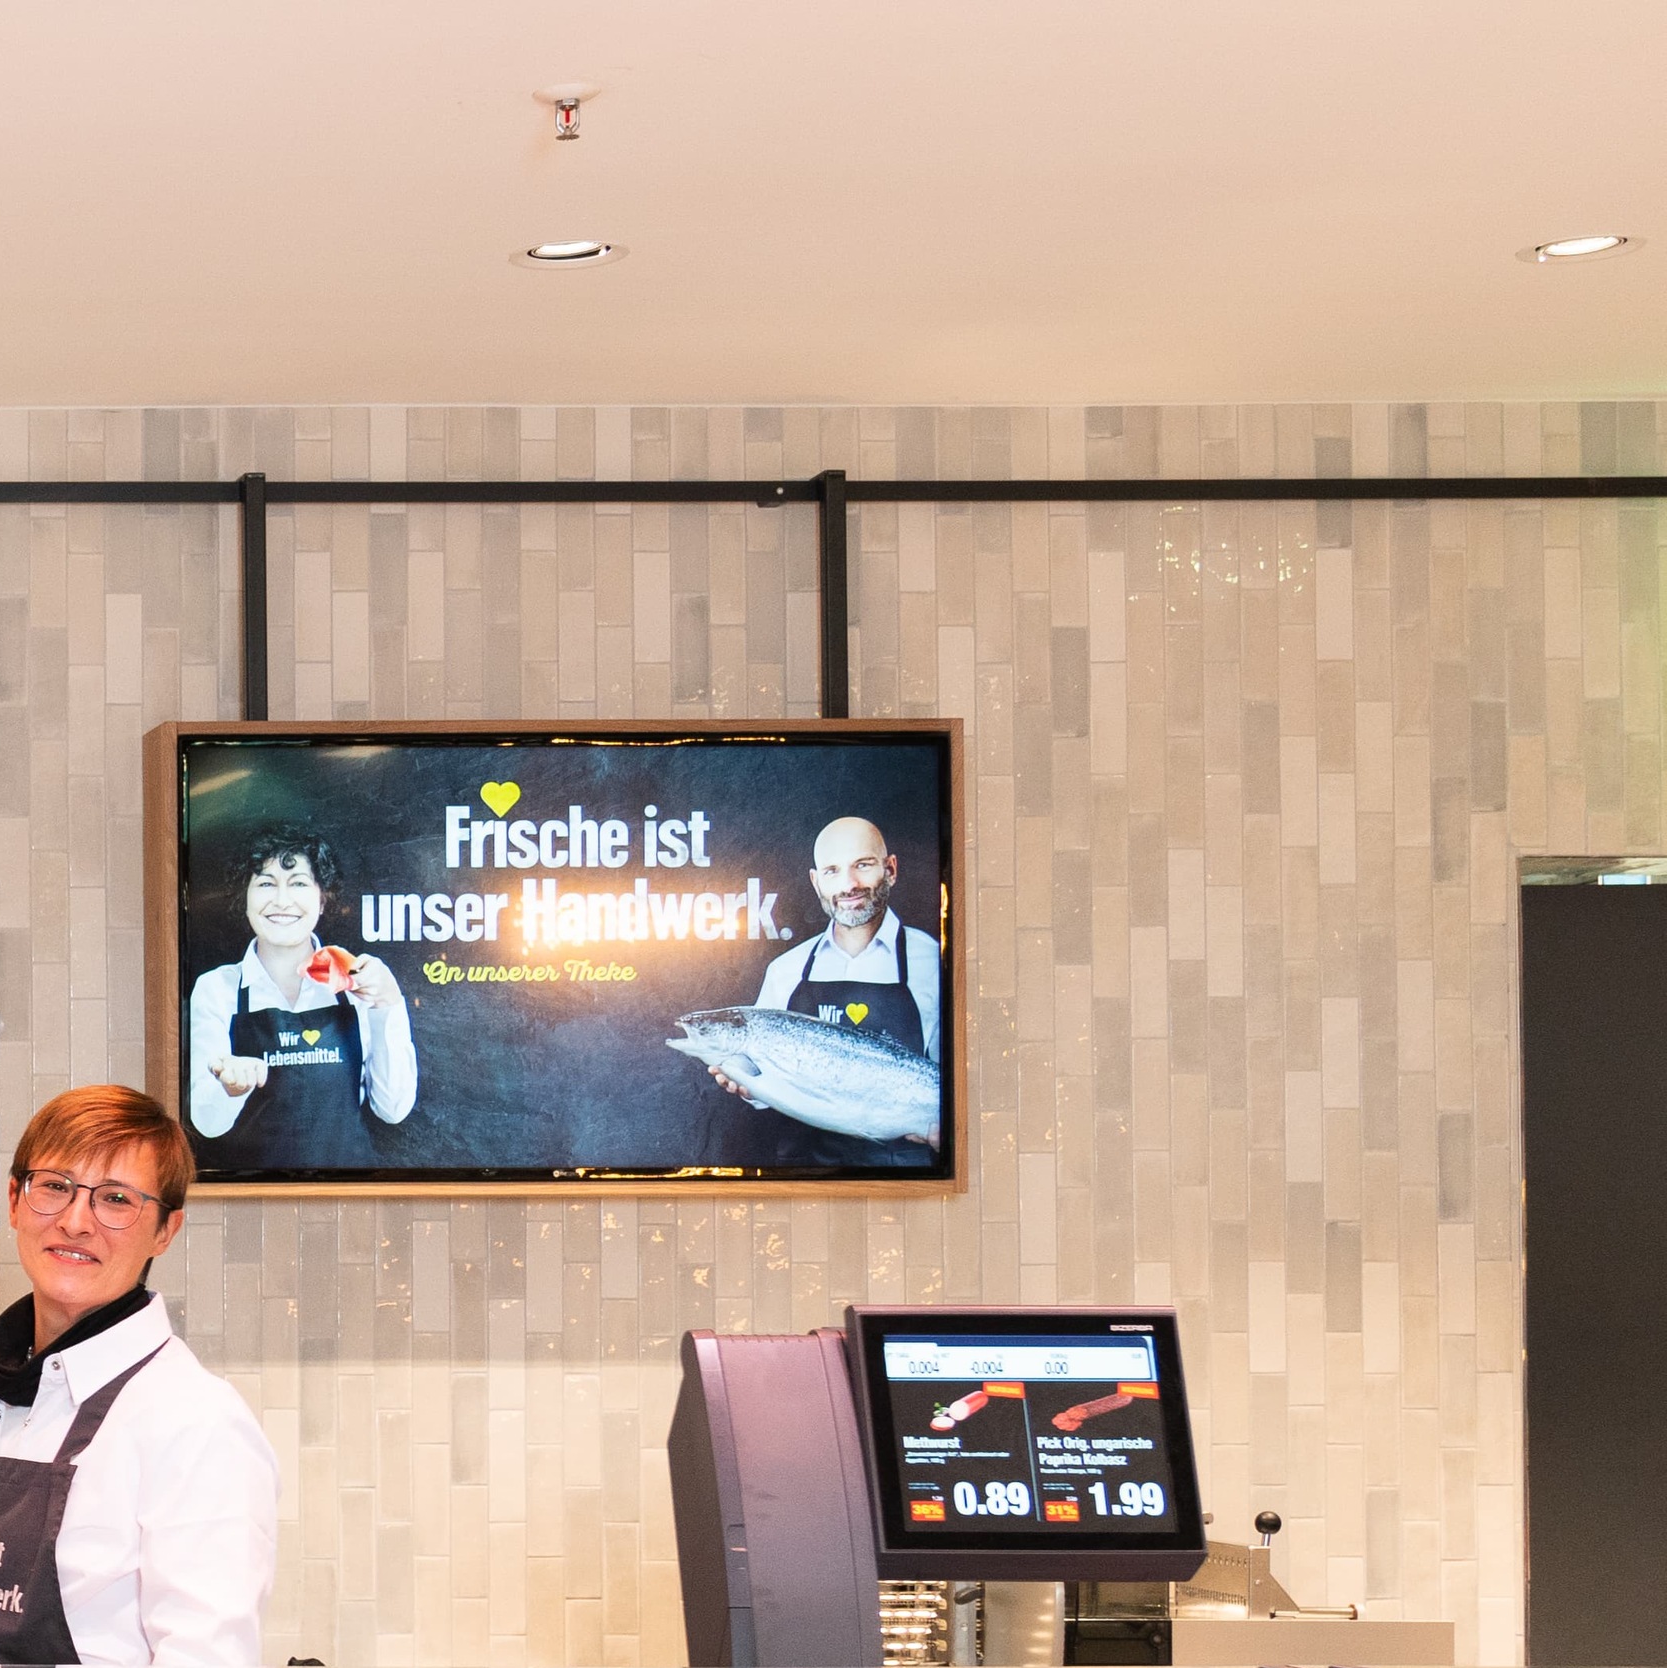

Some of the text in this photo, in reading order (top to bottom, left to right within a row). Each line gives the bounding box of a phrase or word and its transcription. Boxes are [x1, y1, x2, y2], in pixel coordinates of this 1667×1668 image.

[446, 804, 711, 869] Frische ist
[360, 877, 793, 943] unser Handwerk.
[467, 964, 559, 983] unserer
[563, 960, 637, 983] Theke
[819, 1004, 844, 1025] Wir
[278, 1030, 299, 1047] Wir
[263, 1046, 344, 1068] Lebensmittel.
[909, 1361, 1069, 1375] 0.004 -0.004 0.00
[1039, 1453, 1081, 1467] Paprika
[953, 1481, 1031, 1516] 0.89
[1088, 1482, 1165, 1516] 1.99
[1046, 1504, 1077, 1516] 31%
